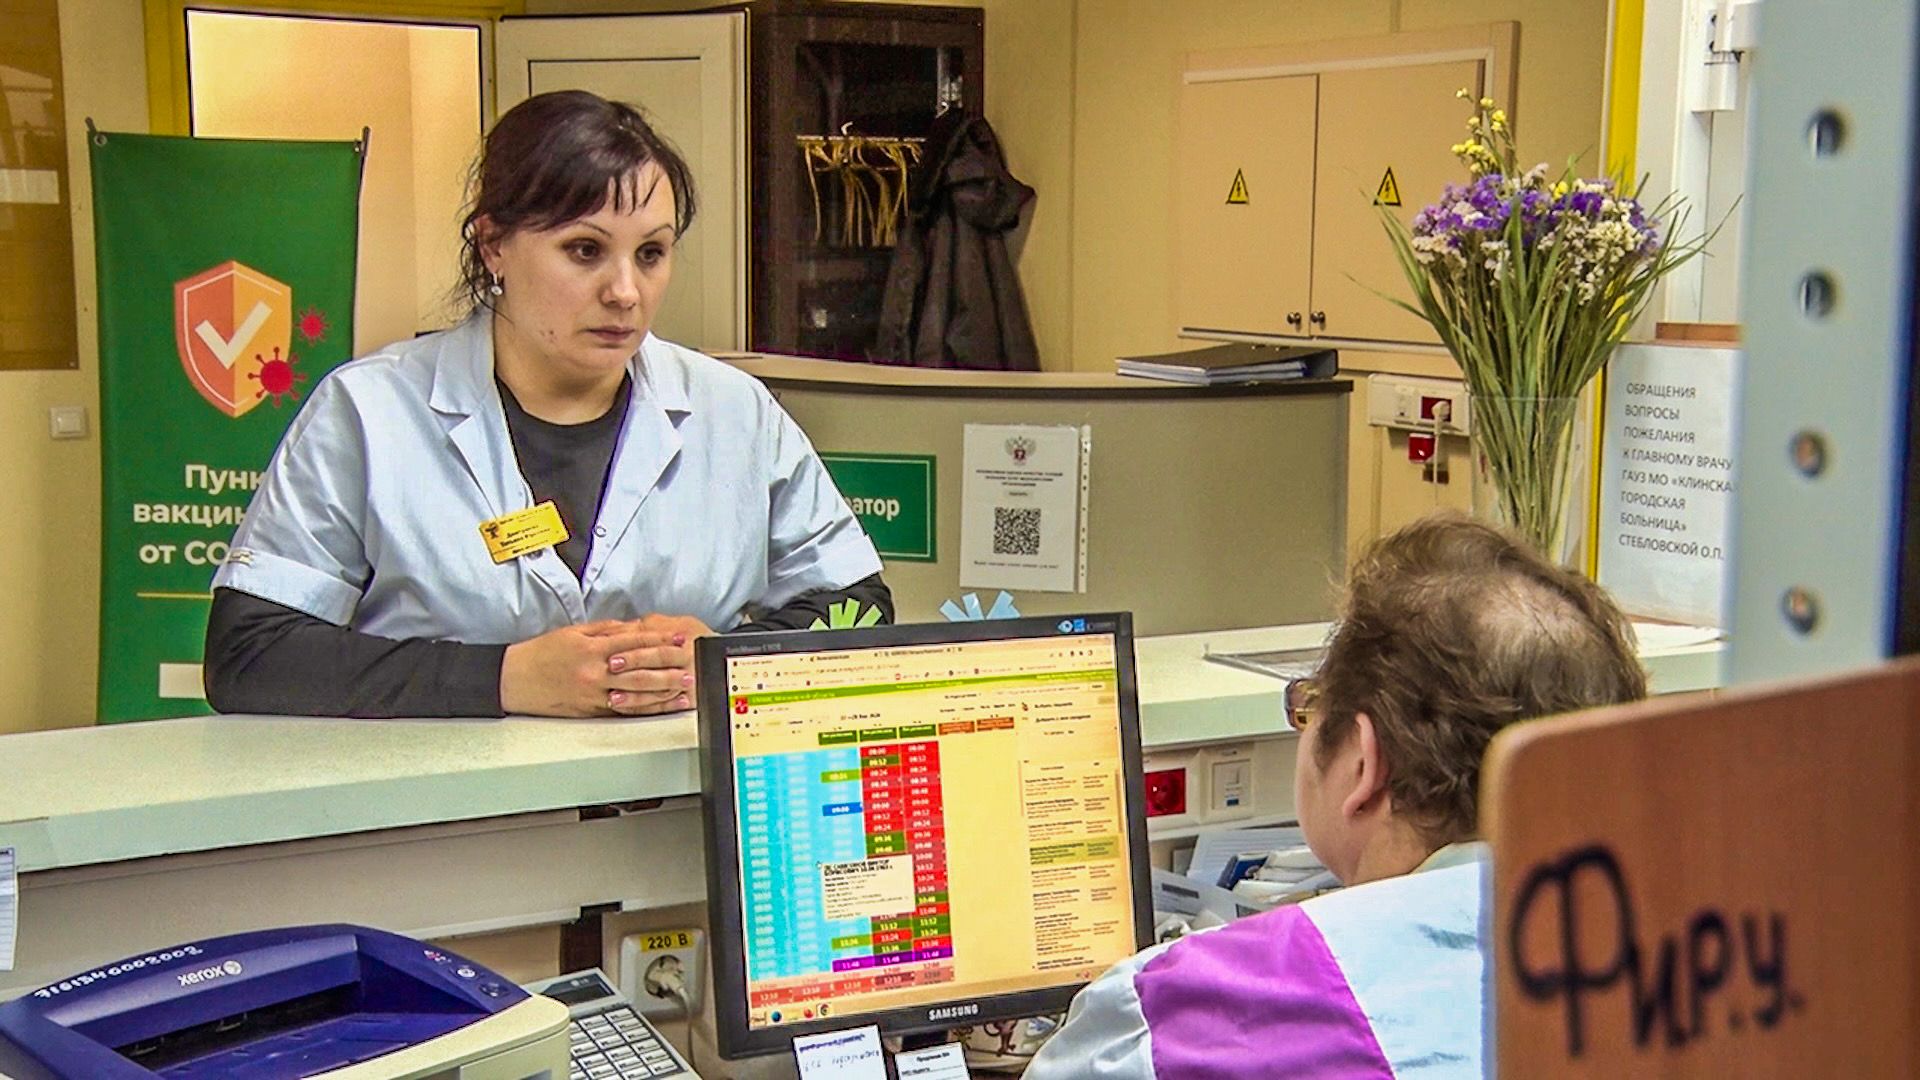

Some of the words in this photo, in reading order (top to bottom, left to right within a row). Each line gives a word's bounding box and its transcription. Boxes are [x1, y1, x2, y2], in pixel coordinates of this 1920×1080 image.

[1626, 382, 1697, 399] ОБРАЩЕНИЯ
[1625, 404, 1680, 420] ВОПРОСЫ
[1623, 426, 1696, 443] ПОЖЕЛАНИЯ
[1622, 449, 1631, 460] К
[1631, 449, 1695, 467] ГЛАВНОМУ
[1696, 455, 1734, 471] ВРАЧУ
[1622, 469, 1646, 484] ГАУЗ
[1648, 473, 1669, 486] МО
[1620, 491, 1686, 510] ГОРОДСКАЯ
[1619, 512, 1687, 533] БОЛЬНИЦА»
[139, 543, 177, 564] от
[1618, 534, 1698, 556] СТЕБЛОВСКОЙ
[648, 936, 671, 950] 220
[177, 964, 226, 987] xerox
[928, 1003, 979, 1021] SAMSUNG
